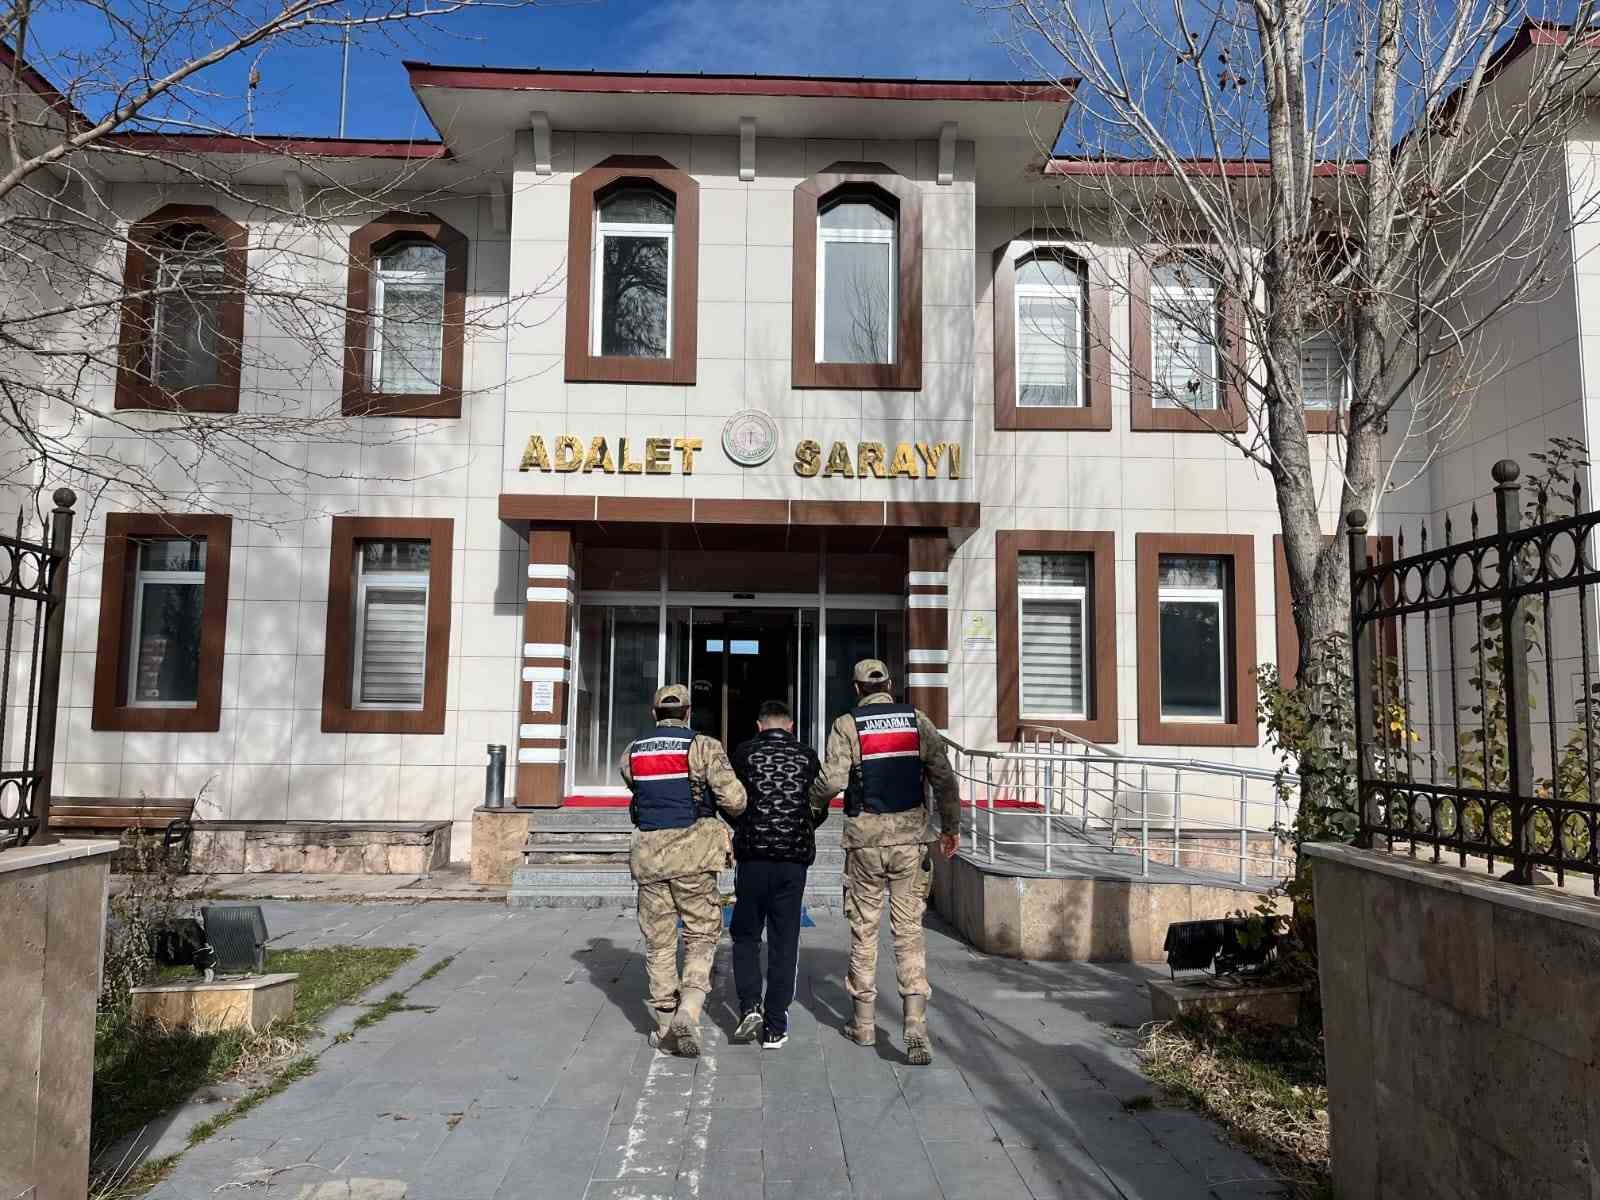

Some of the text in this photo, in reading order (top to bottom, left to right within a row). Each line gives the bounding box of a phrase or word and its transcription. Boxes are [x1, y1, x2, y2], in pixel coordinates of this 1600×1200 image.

[519, 434, 703, 476] ADALET
[793, 440, 961, 480] SARAYI
[865, 717, 911, 730] JANDARMA
